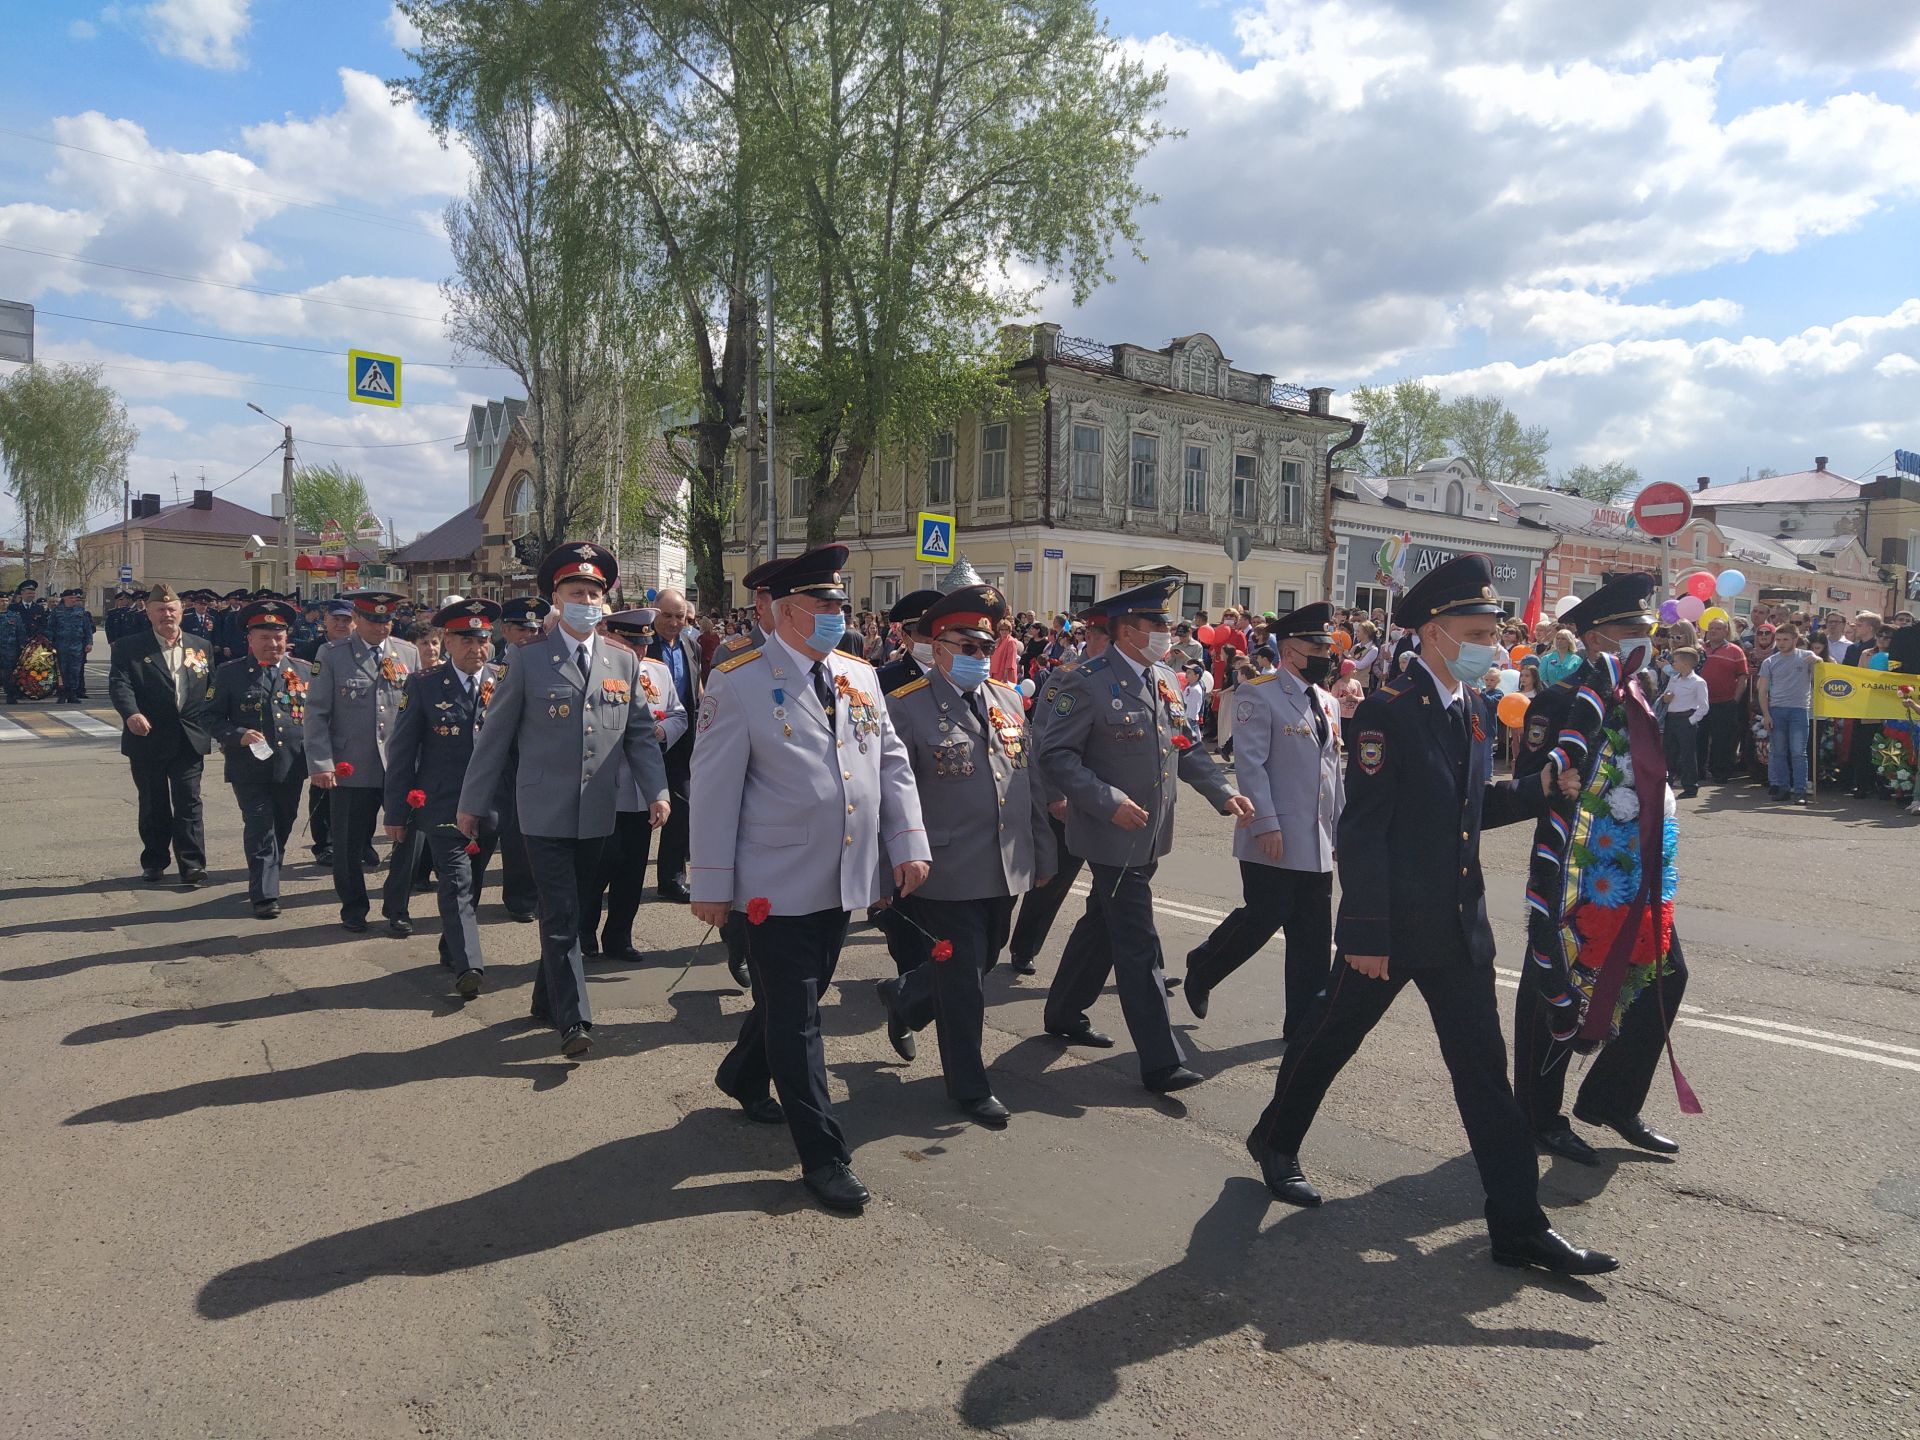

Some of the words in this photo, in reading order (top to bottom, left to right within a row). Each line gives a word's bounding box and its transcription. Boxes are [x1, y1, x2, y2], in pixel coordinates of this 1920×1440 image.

[1593, 508, 1626, 527] АПТЕКА
[1413, 549, 1456, 574] AVE
[1493, 563, 1517, 582] афе
[1828, 683, 1848, 691] КИУ
[1861, 683, 1916, 692] КАЗАНС
